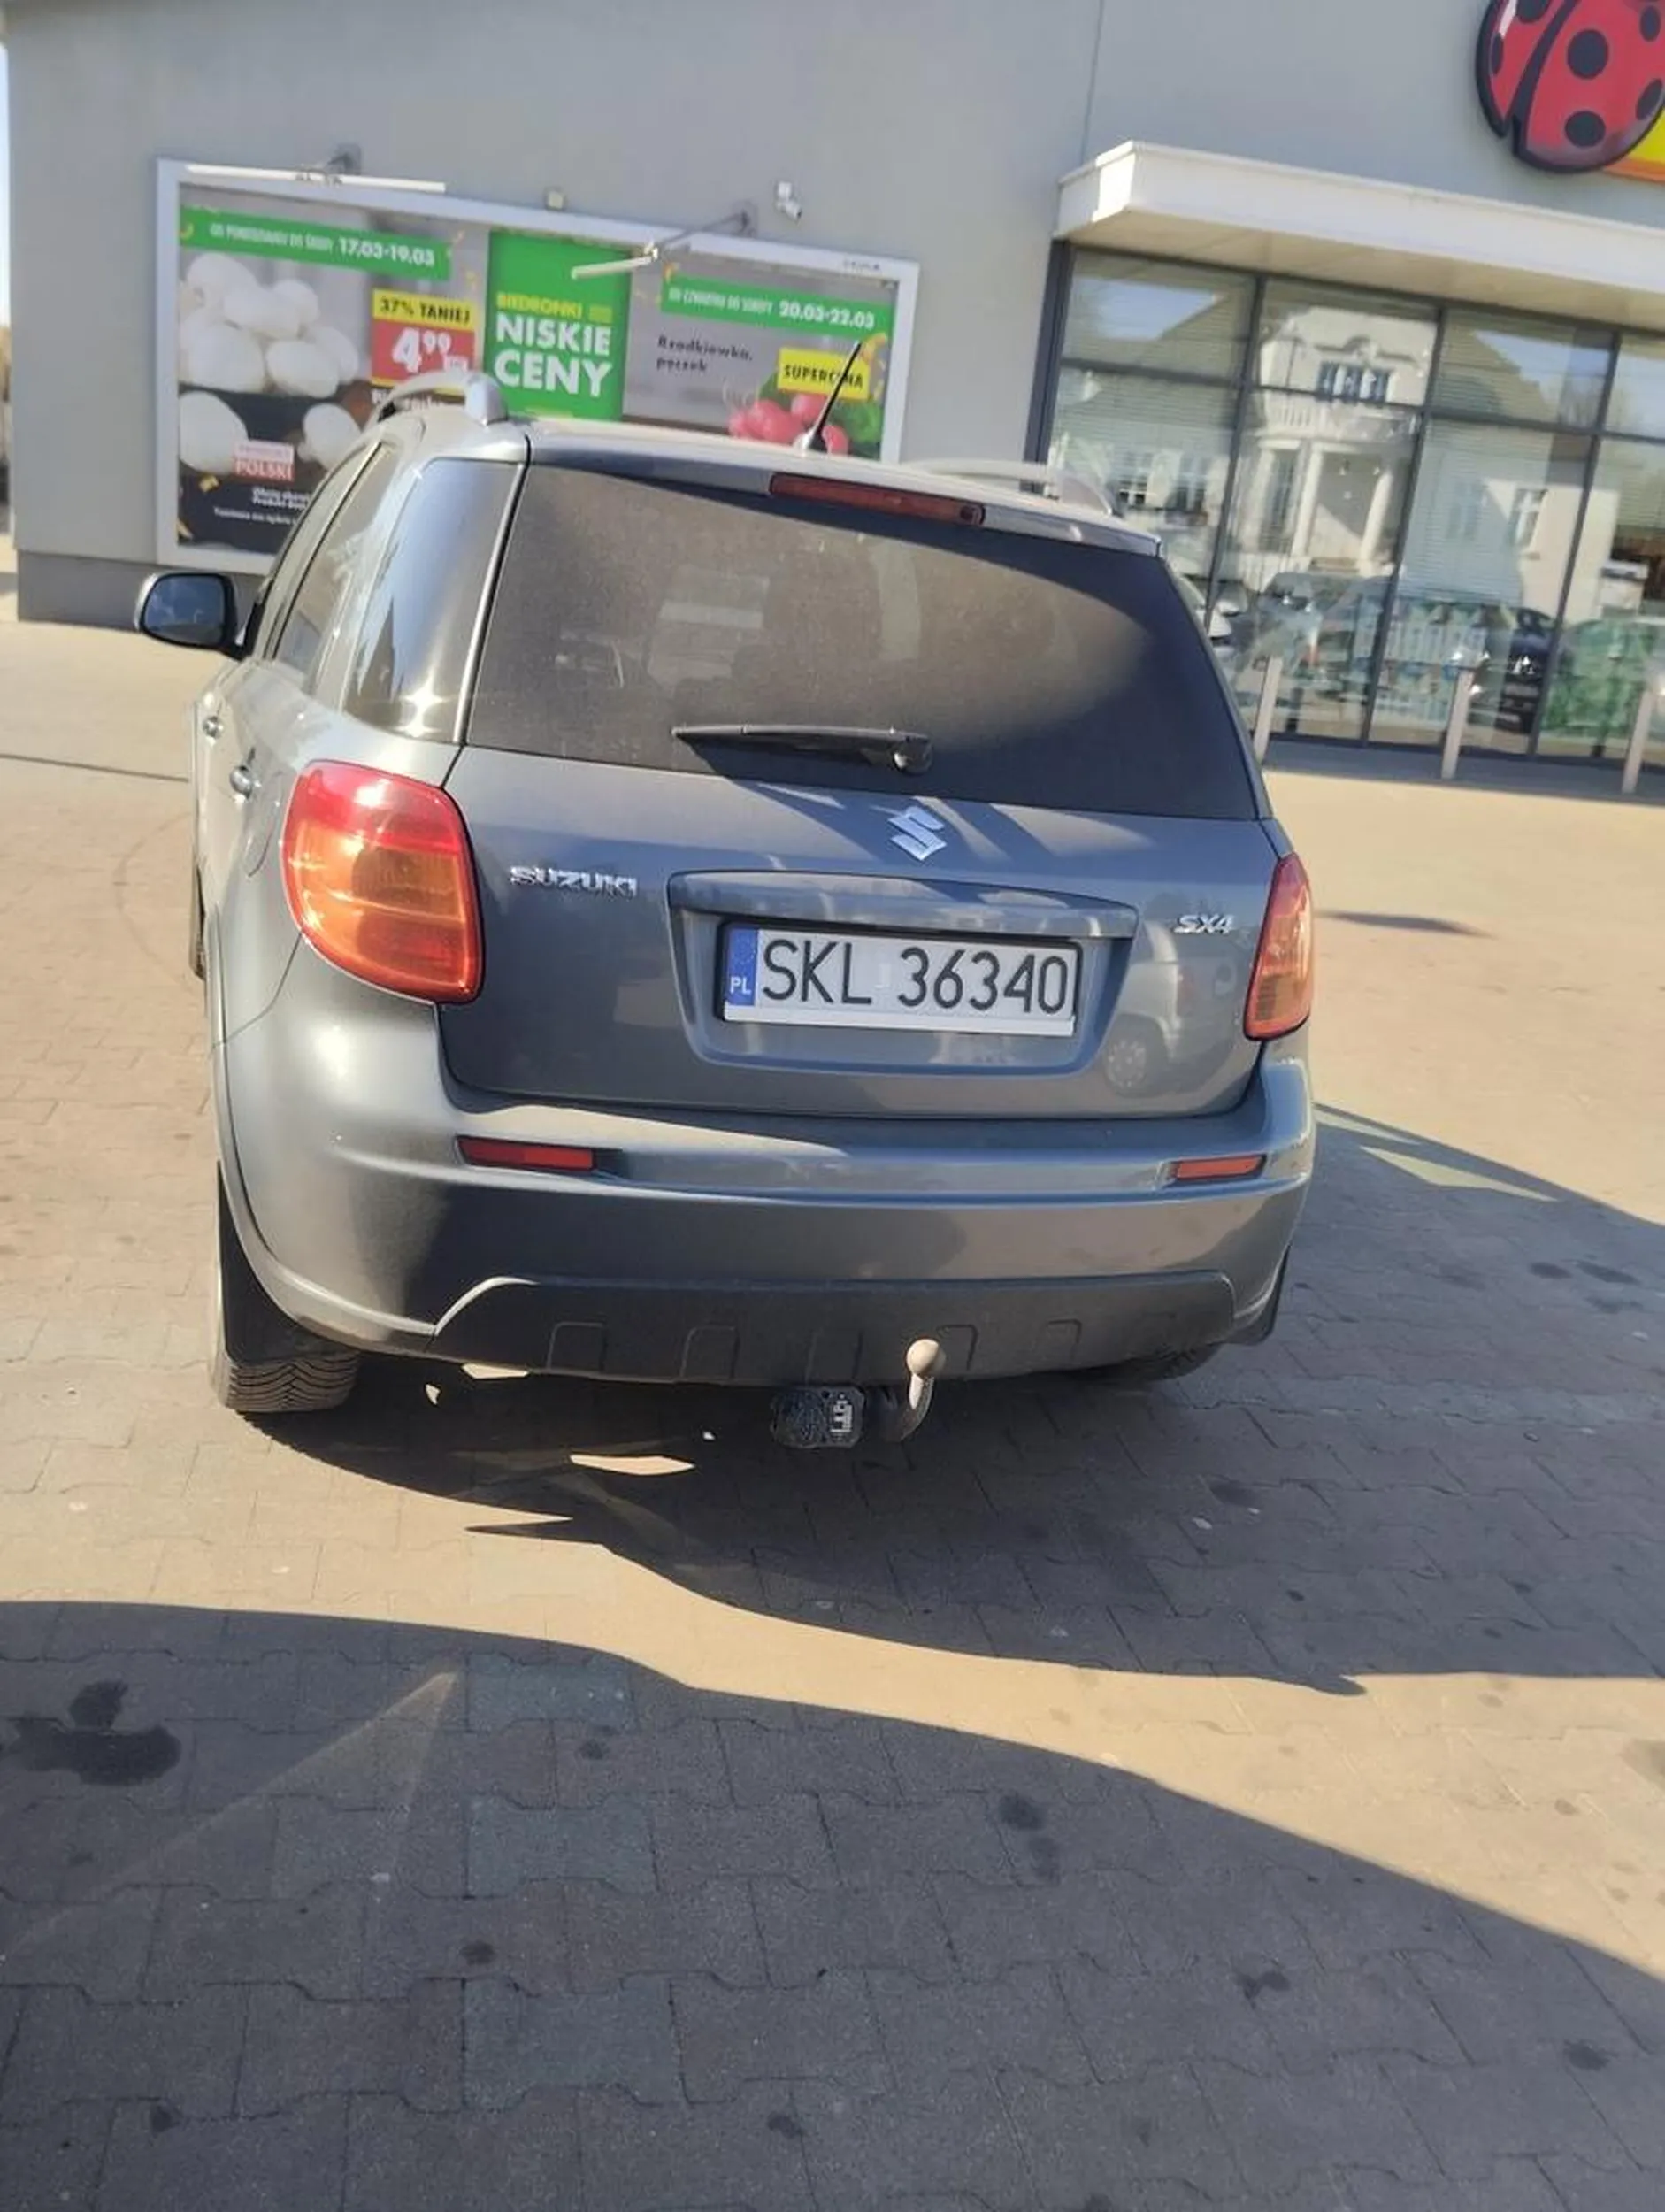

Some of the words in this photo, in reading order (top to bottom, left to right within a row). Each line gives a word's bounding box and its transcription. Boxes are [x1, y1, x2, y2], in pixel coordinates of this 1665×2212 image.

[339, 236, 436, 267] 17.03-19.03
[380, 296, 415, 316] 37%
[419, 302, 471, 324] TANIEJ
[779, 299, 876, 330] 20.03-22.03
[495, 311, 612, 357] NISKIE
[494, 348, 613, 397] CENY
[234, 458, 295, 482] POLSKI
[509, 864, 639, 899] SUZUKI
[1173, 914, 1236, 935] SX4
[730, 976, 752, 996] PL
[762, 938, 873, 1005] SKL
[897, 946, 1070, 1016] 36340
